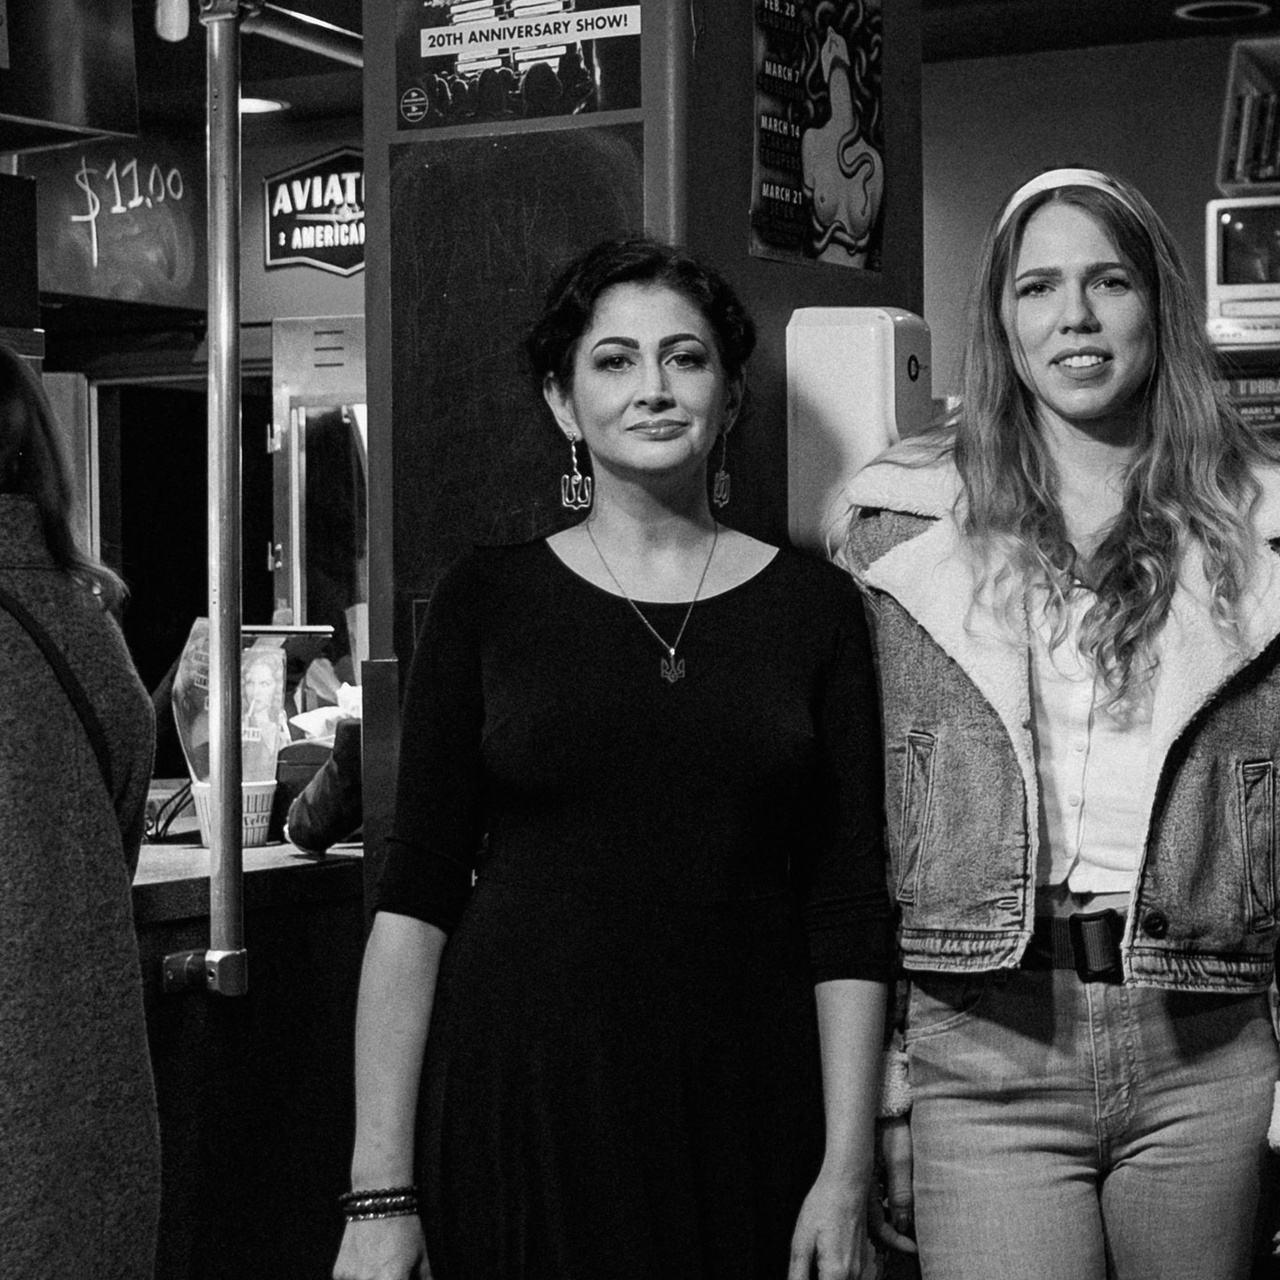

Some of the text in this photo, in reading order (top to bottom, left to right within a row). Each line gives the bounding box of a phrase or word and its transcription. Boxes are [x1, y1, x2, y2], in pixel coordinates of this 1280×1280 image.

[784, 3, 797, 19] 28
[427, 13, 628, 49] 20TH ANNIVERSARY SHOW!
[764, 60, 800, 85] MARCH 7
[760, 114, 801, 139] MARCH 14
[272, 171, 365, 218] AVIAT
[762, 182, 803, 206] MARCH 21
[70, 155, 184, 269] $11.00
